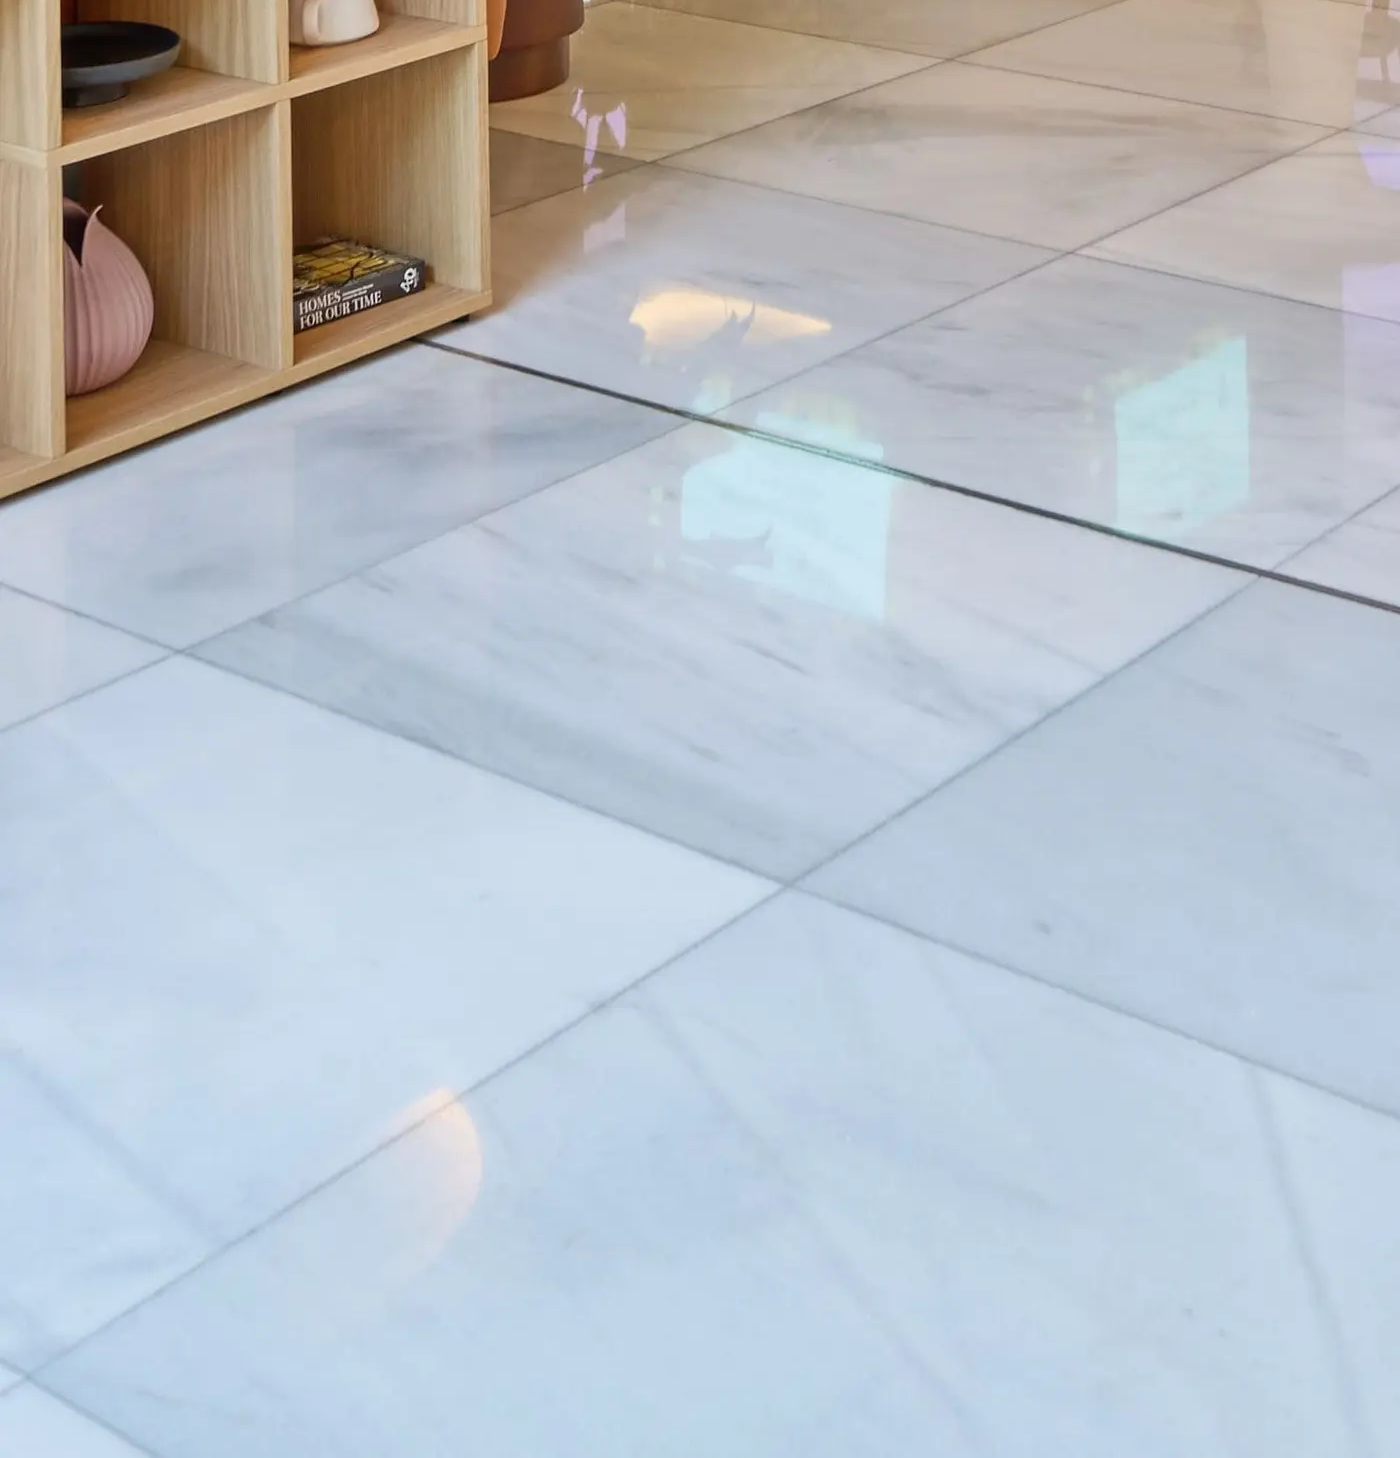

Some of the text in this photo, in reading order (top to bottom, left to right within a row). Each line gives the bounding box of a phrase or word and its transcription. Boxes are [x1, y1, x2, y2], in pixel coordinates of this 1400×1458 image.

[299, 290, 341, 315] HOMES
[300, 310, 324, 330] FOR
[325, 301, 351, 323] OUR
[352, 290, 383, 312] TIME
